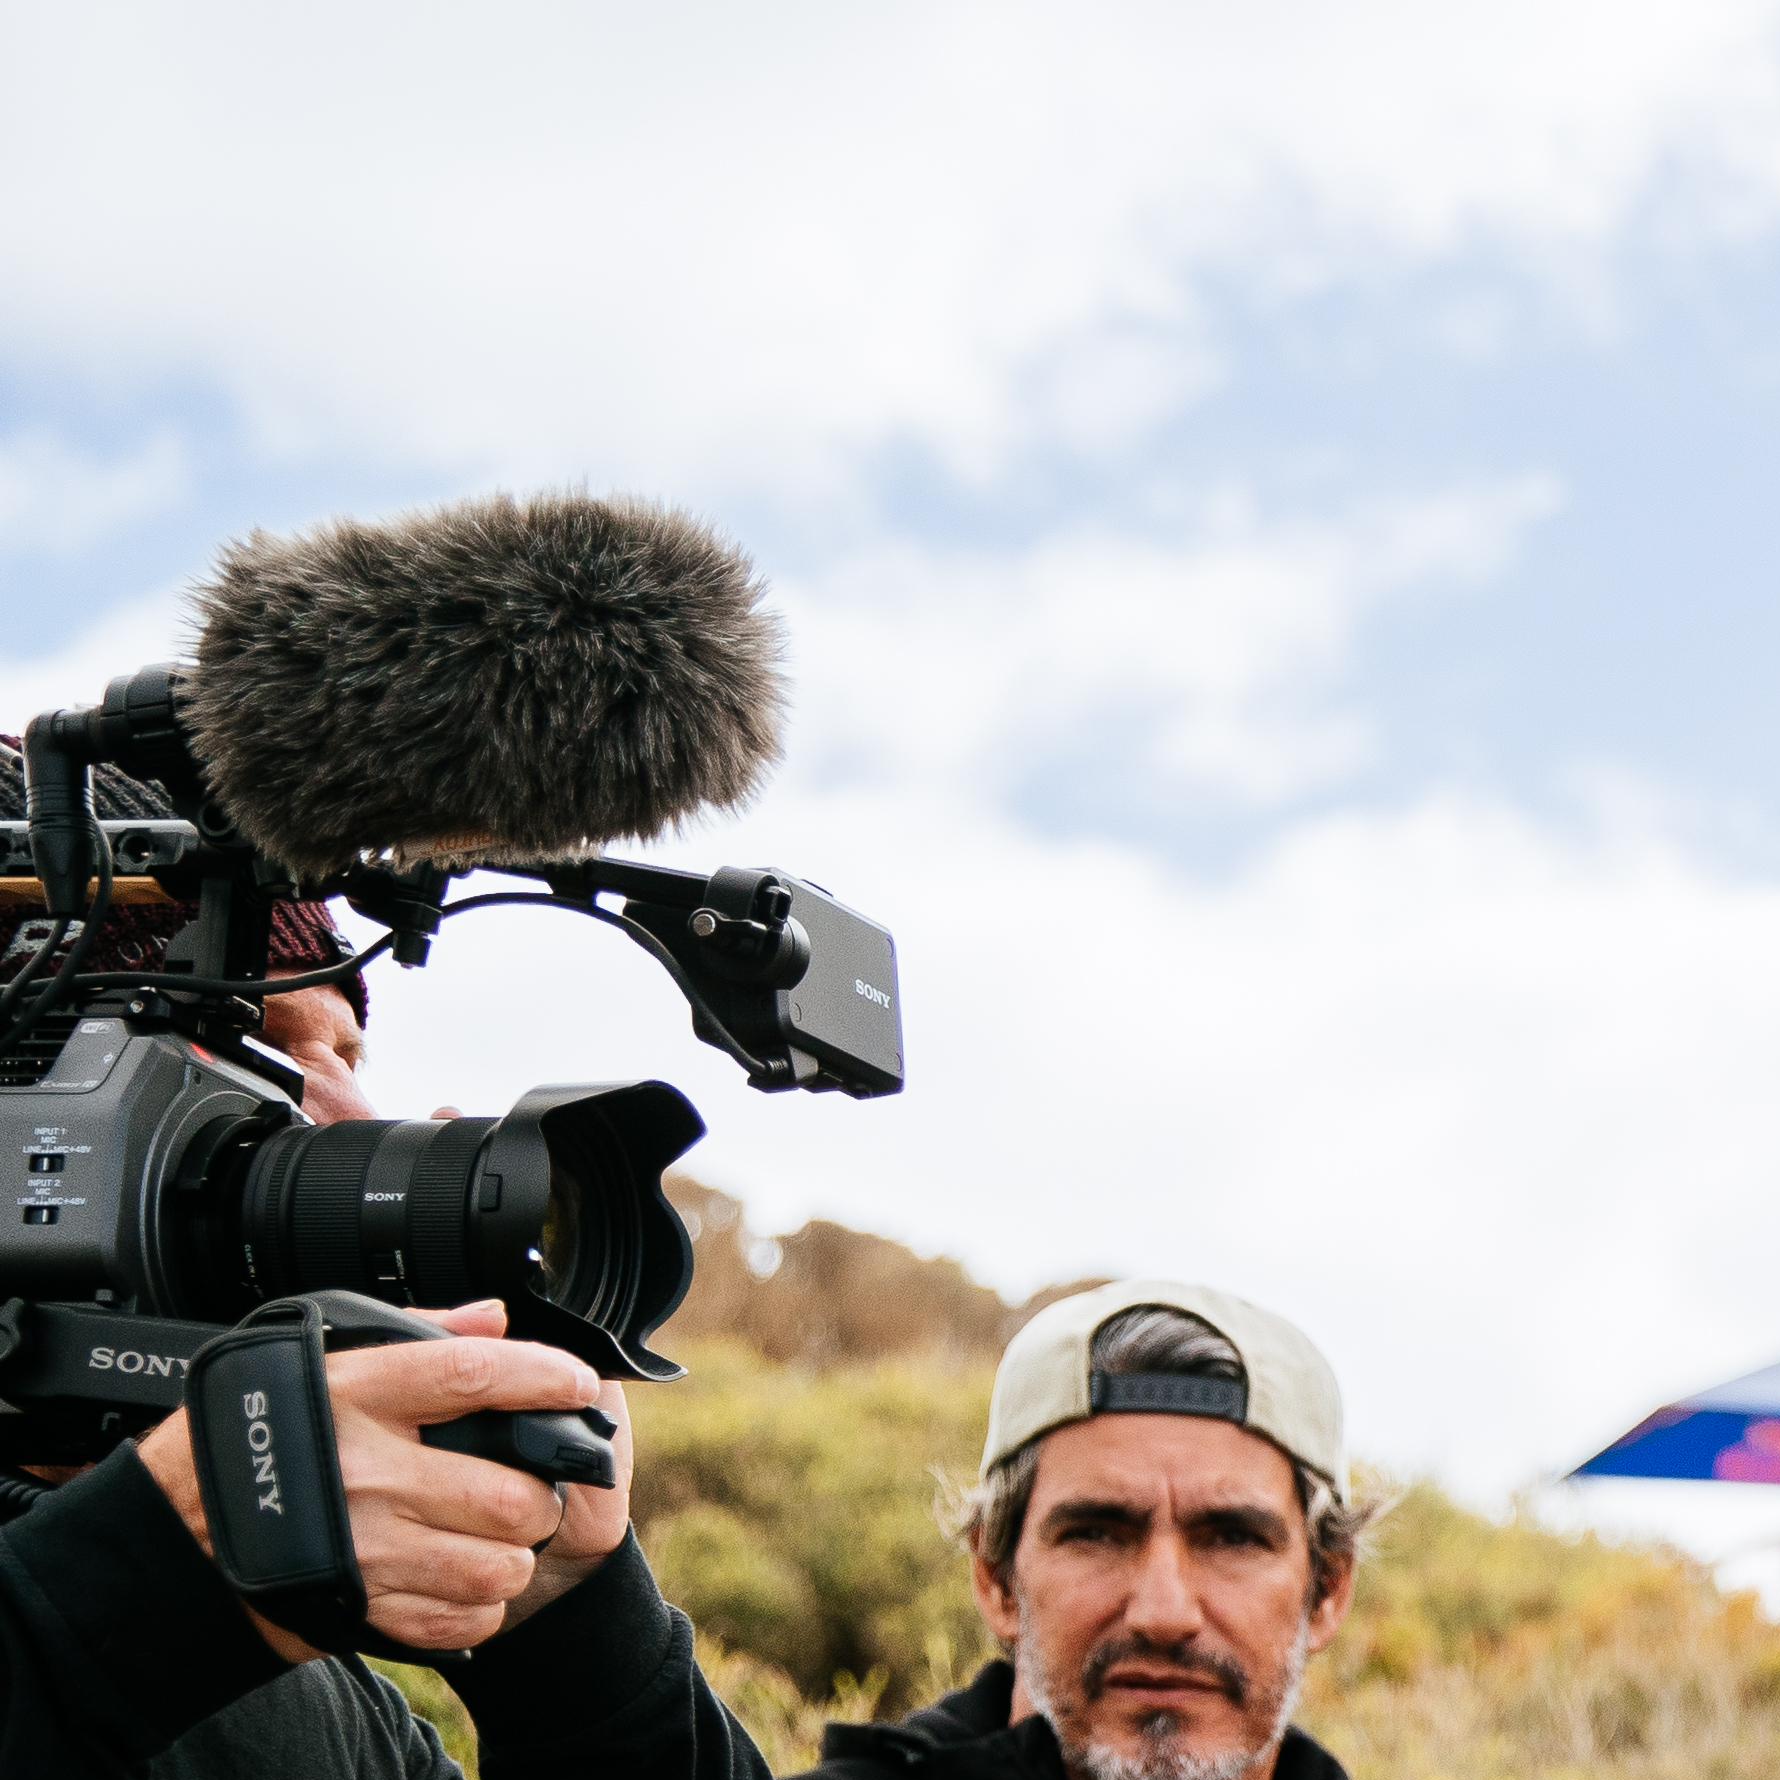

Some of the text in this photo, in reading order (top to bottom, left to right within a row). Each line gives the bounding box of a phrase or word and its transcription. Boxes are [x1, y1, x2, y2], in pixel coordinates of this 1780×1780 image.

[855, 978, 891, 1009] SONY
[34, 1127, 59, 1135] INPUT
[28, 1179, 52, 1187] INPUT
[364, 1192, 405, 1202] SONY
[243, 1390, 284, 1515] SONY
